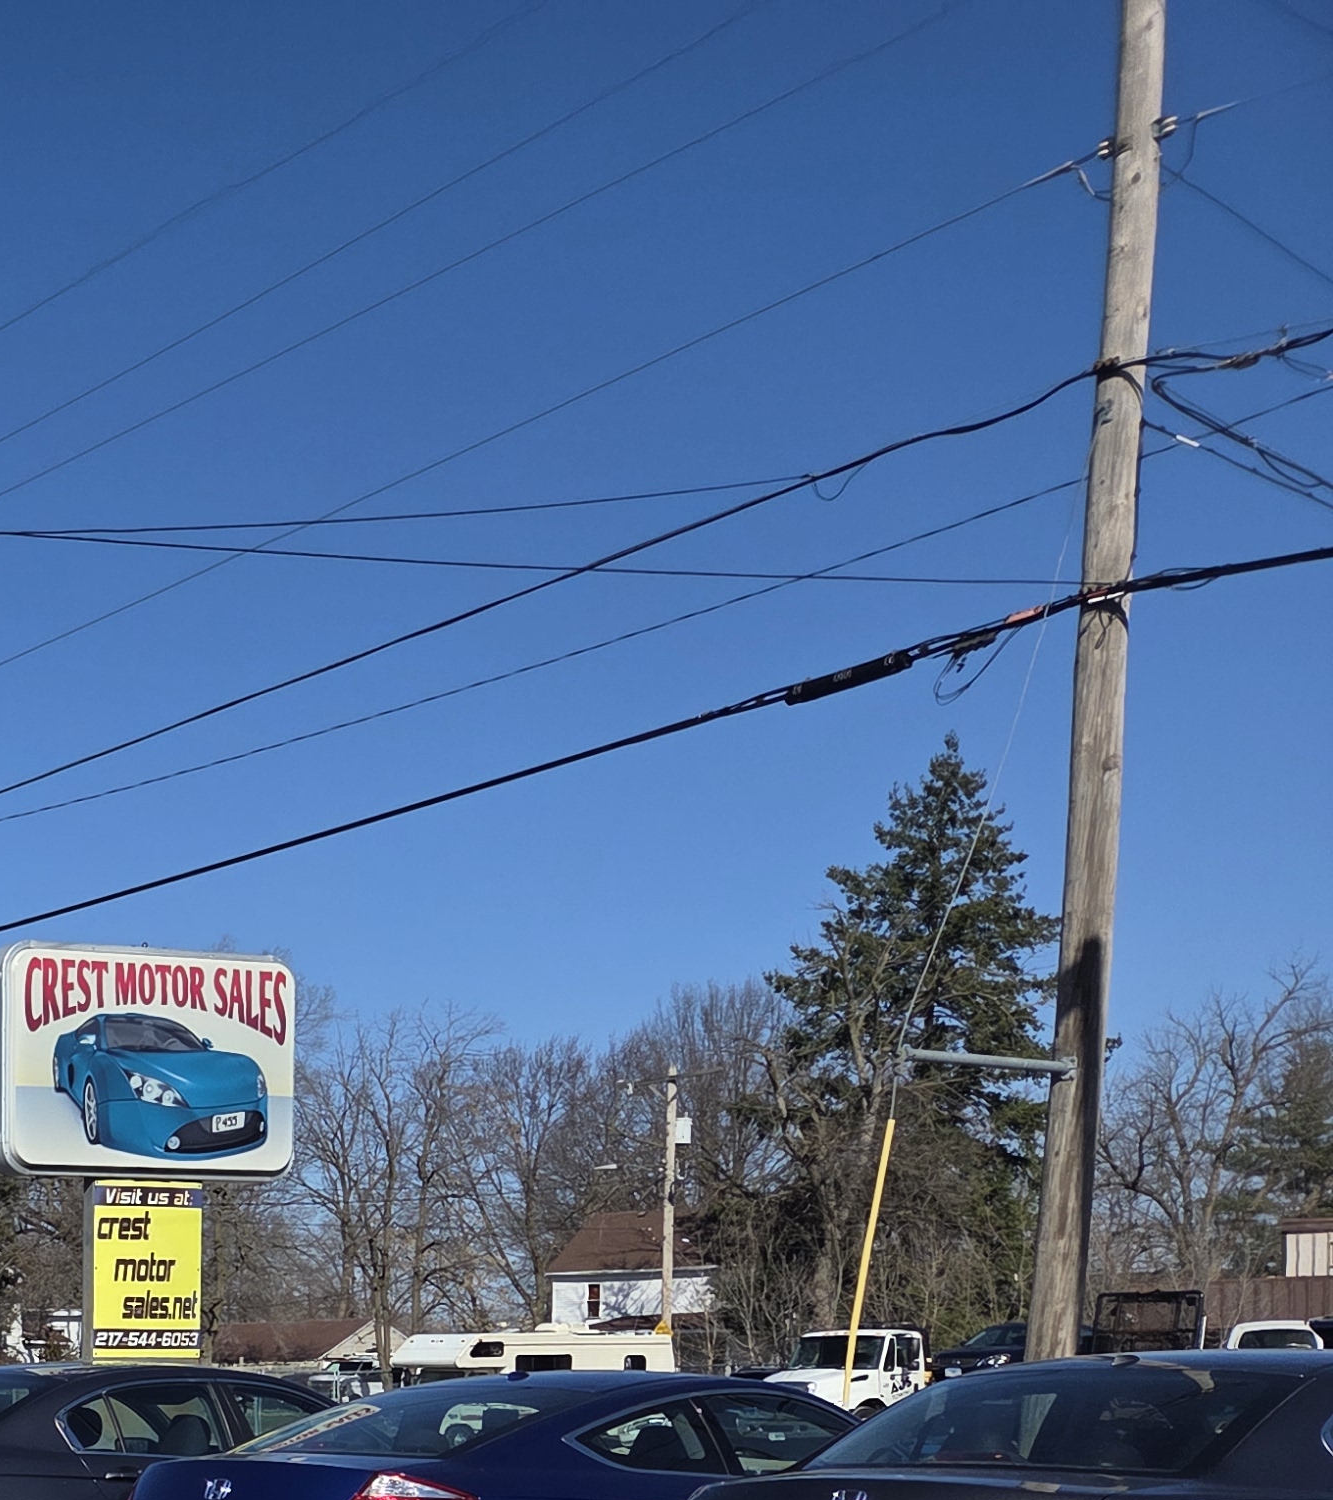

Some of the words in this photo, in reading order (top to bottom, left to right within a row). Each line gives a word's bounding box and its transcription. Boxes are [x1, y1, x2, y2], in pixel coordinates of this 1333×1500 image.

[24, 956, 108, 1032] CREST
[115, 962, 208, 1012] MOTOR
[213, 967, 287, 1046] SALES
[105, 1188, 143, 1205] Visit
[147, 1192, 169, 1205] us
[173, 1190, 194, 1206] at:
[97, 1211, 151, 1240] crest
[114, 1252, 176, 1282] motor
[122, 1290, 198, 1320] sales.net
[95, 1331, 199, 1347] 217-544-6053
